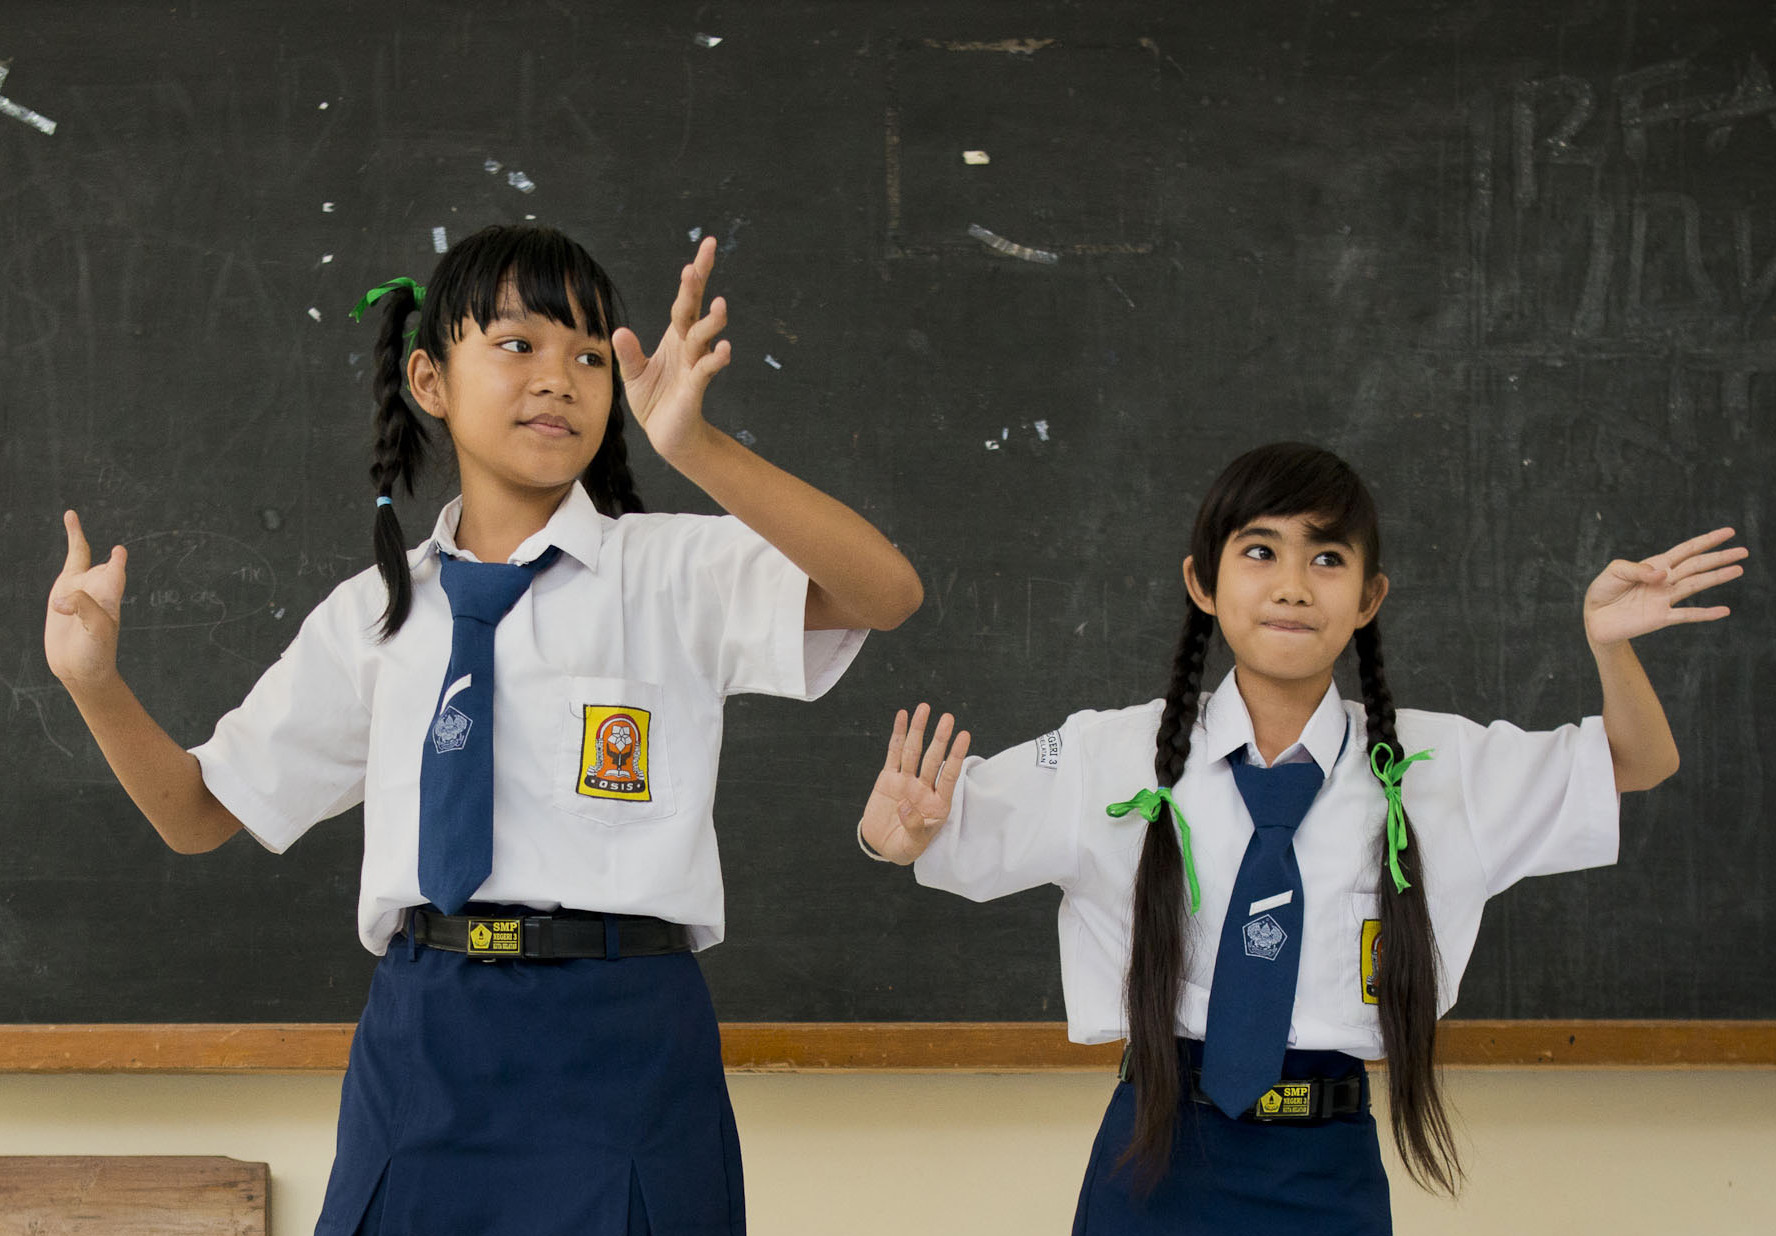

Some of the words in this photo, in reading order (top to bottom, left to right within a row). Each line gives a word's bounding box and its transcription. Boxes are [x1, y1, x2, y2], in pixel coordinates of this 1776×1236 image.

[1046, 731, 1058, 756] EGERI
[599, 781, 634, 791] OSIS
[493, 922, 517, 931] SMP
[513, 932, 517, 940] 3
[1283, 1087, 1308, 1096] SMP
